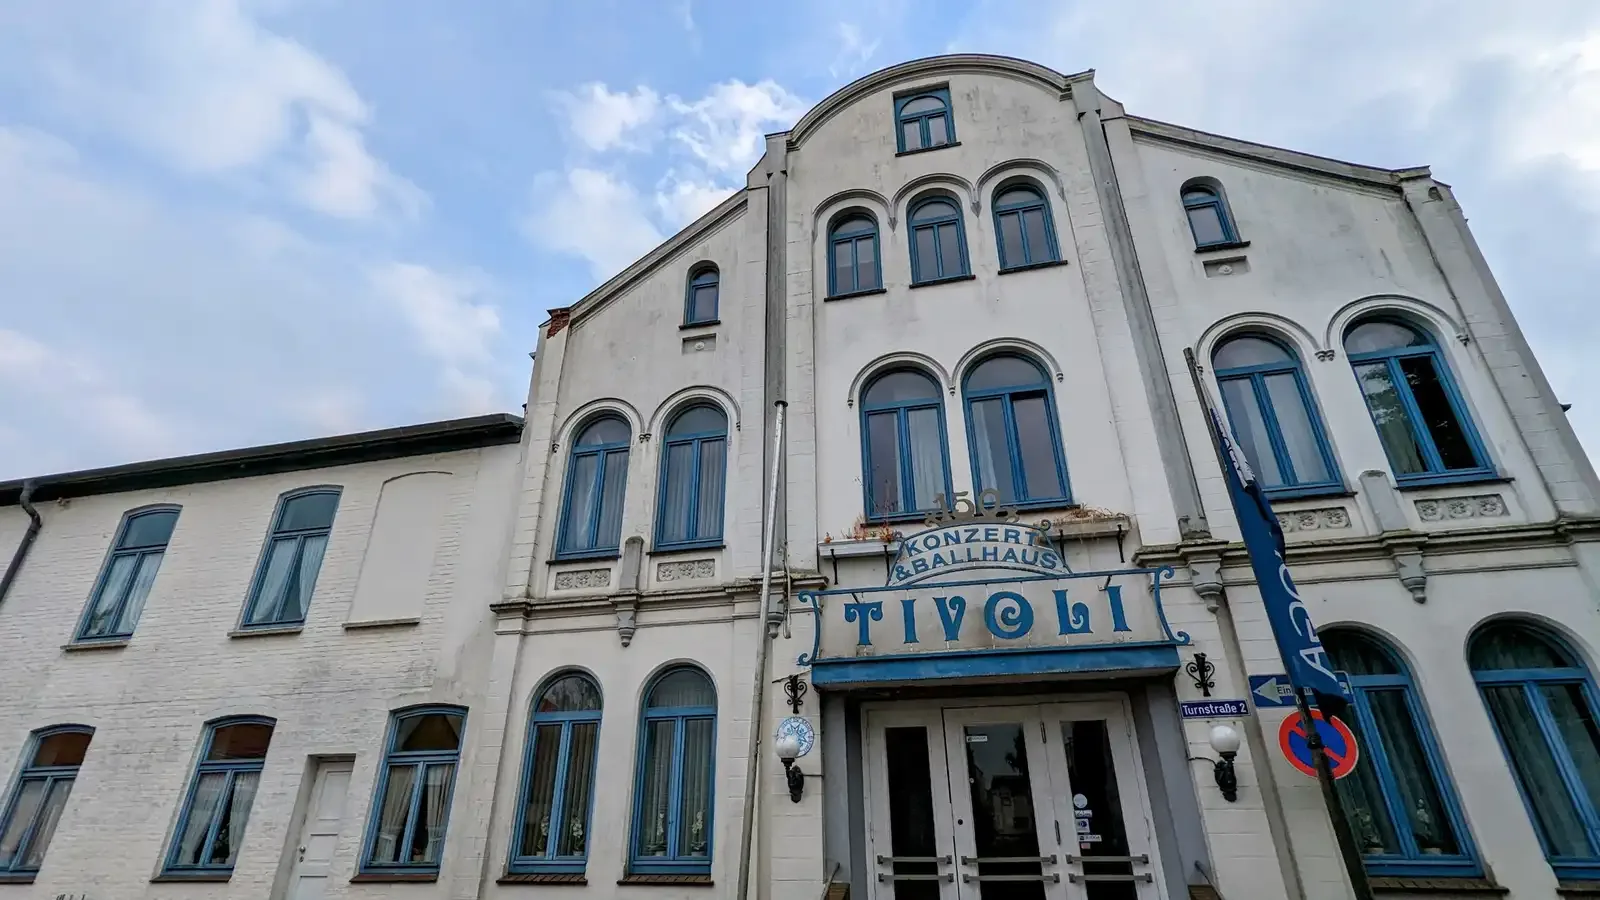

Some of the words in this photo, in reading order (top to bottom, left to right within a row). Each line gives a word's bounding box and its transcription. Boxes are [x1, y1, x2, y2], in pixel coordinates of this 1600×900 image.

[933, 488, 1001, 523] 150
[906, 528, 1039, 557] KONZERT
[844, 585, 1132, 646] TIVOLI
[1182, 703, 1237, 715] Turnstraße
[1239, 701, 1247, 713] 2
